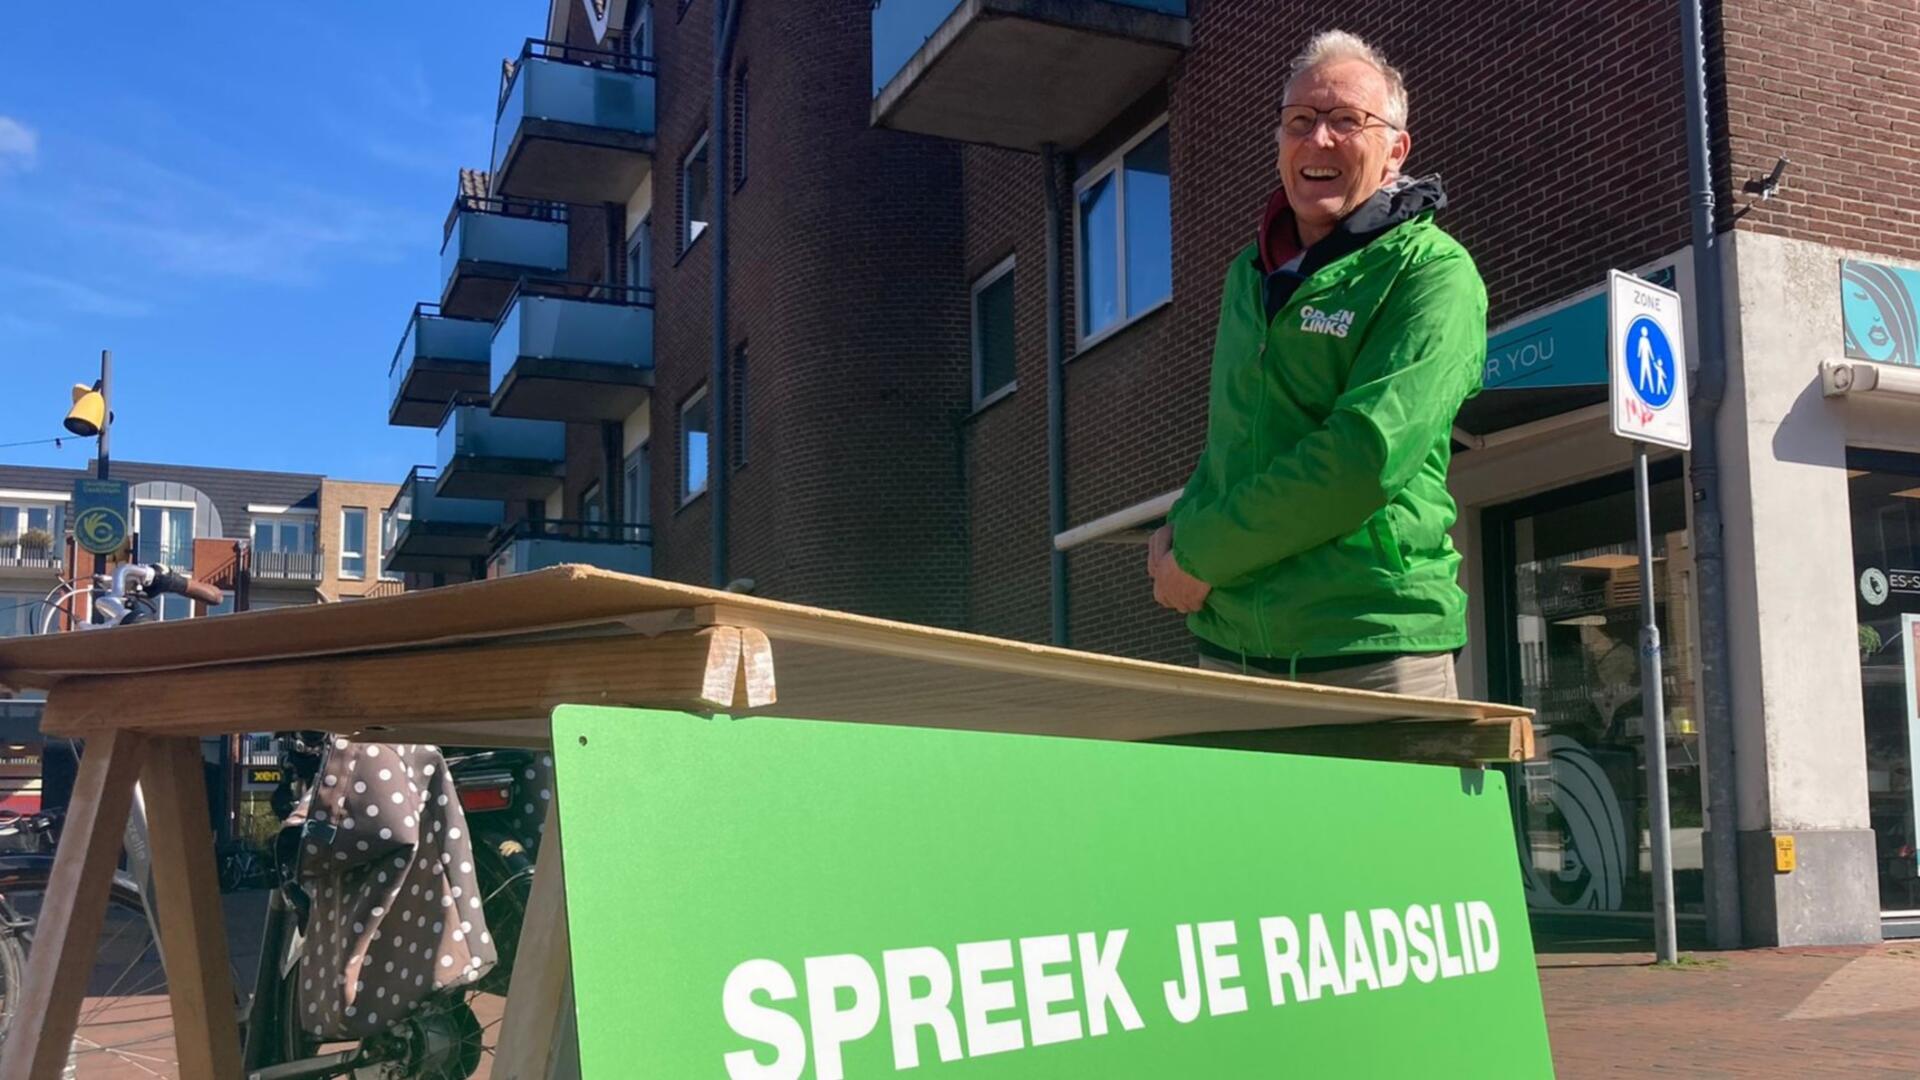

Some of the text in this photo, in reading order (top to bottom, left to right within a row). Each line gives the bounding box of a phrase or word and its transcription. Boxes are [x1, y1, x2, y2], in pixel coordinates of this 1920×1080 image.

[1634, 290, 1661, 312] ZONE
[1300, 318, 1349, 338] LINKS
[1483, 336, 1554, 381] R YOU
[723, 901, 1499, 1080] SPREEK JE RAADSLID
